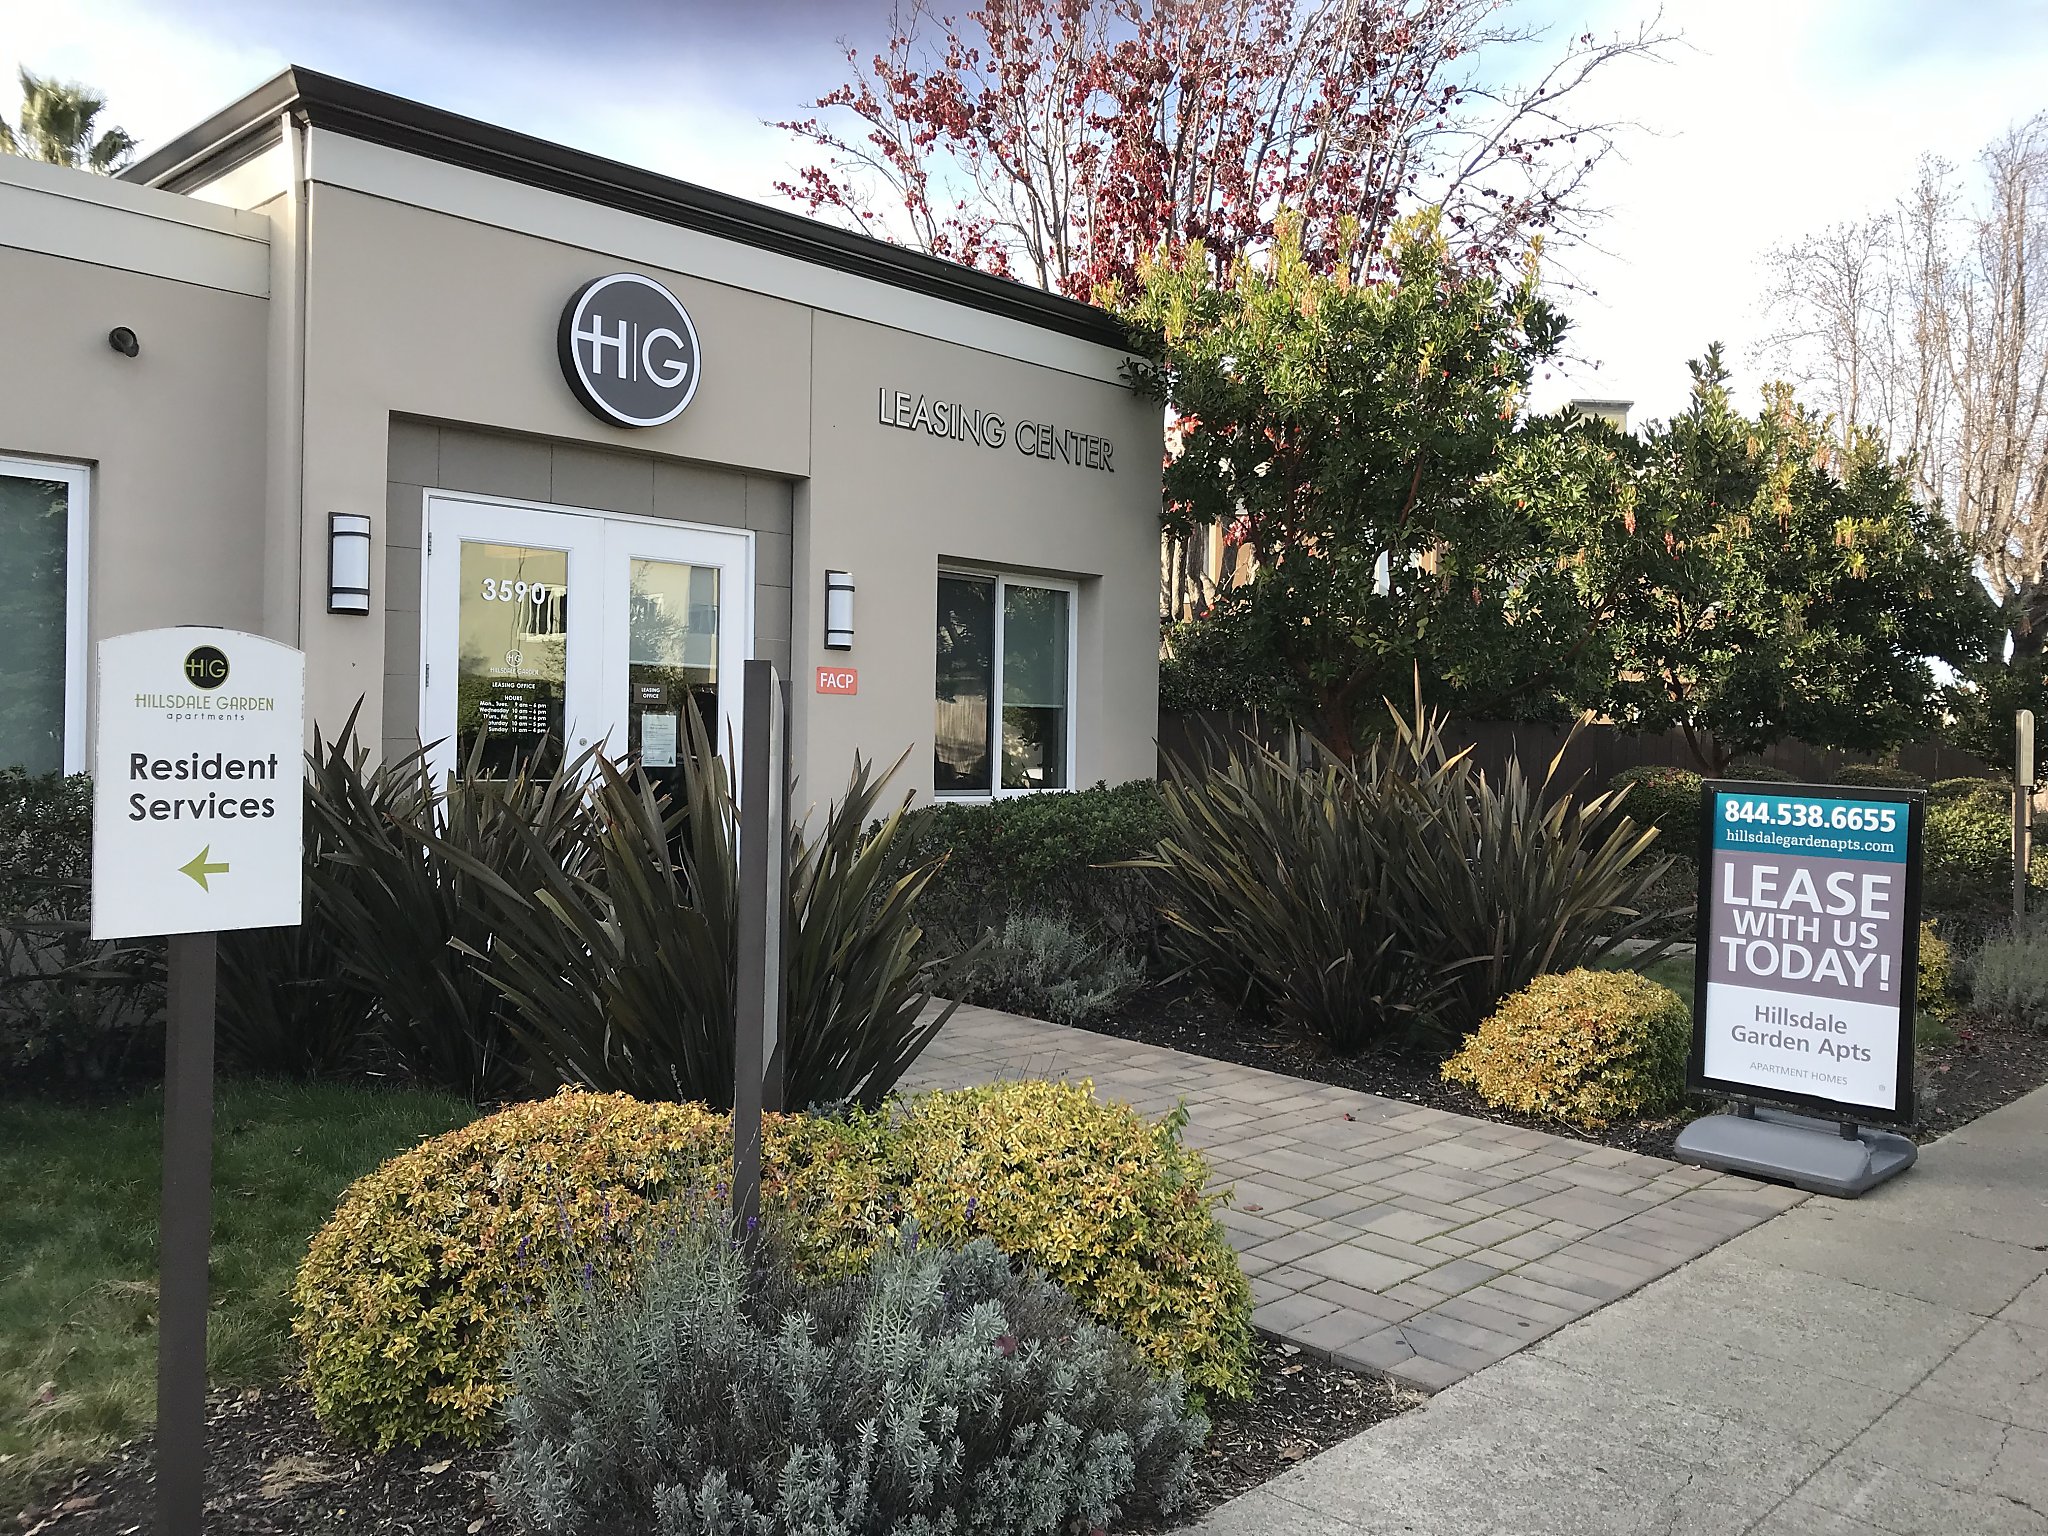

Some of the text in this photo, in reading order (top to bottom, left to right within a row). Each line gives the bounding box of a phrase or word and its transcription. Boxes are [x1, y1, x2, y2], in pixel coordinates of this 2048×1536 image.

[879, 387, 1115, 473] LEASING CENTER
[482, 578, 546, 604] 3590
[492, 681, 515, 689] LEASING
[820, 672, 854, 689] FACP
[134, 693, 274, 711] HILLSDALE GARDEN
[166, 712, 245, 722] apartments
[130, 752, 278, 780] Resident
[129, 792, 275, 821] Services
[1725, 800, 1896, 833] 844.538.6655
[1725, 828, 1895, 853] hillsdalegardenapts.com
[1723, 863, 1891, 920] LEASE
[1732, 909, 1879, 949] WITH US
[1720, 936, 1891, 991] TODAY!
[1755, 1005, 1847, 1034] Hillsdale
[1731, 1024, 1871, 1063] Garden Apts
[1750, 1061, 1848, 1086] APARTMENT HOMES
